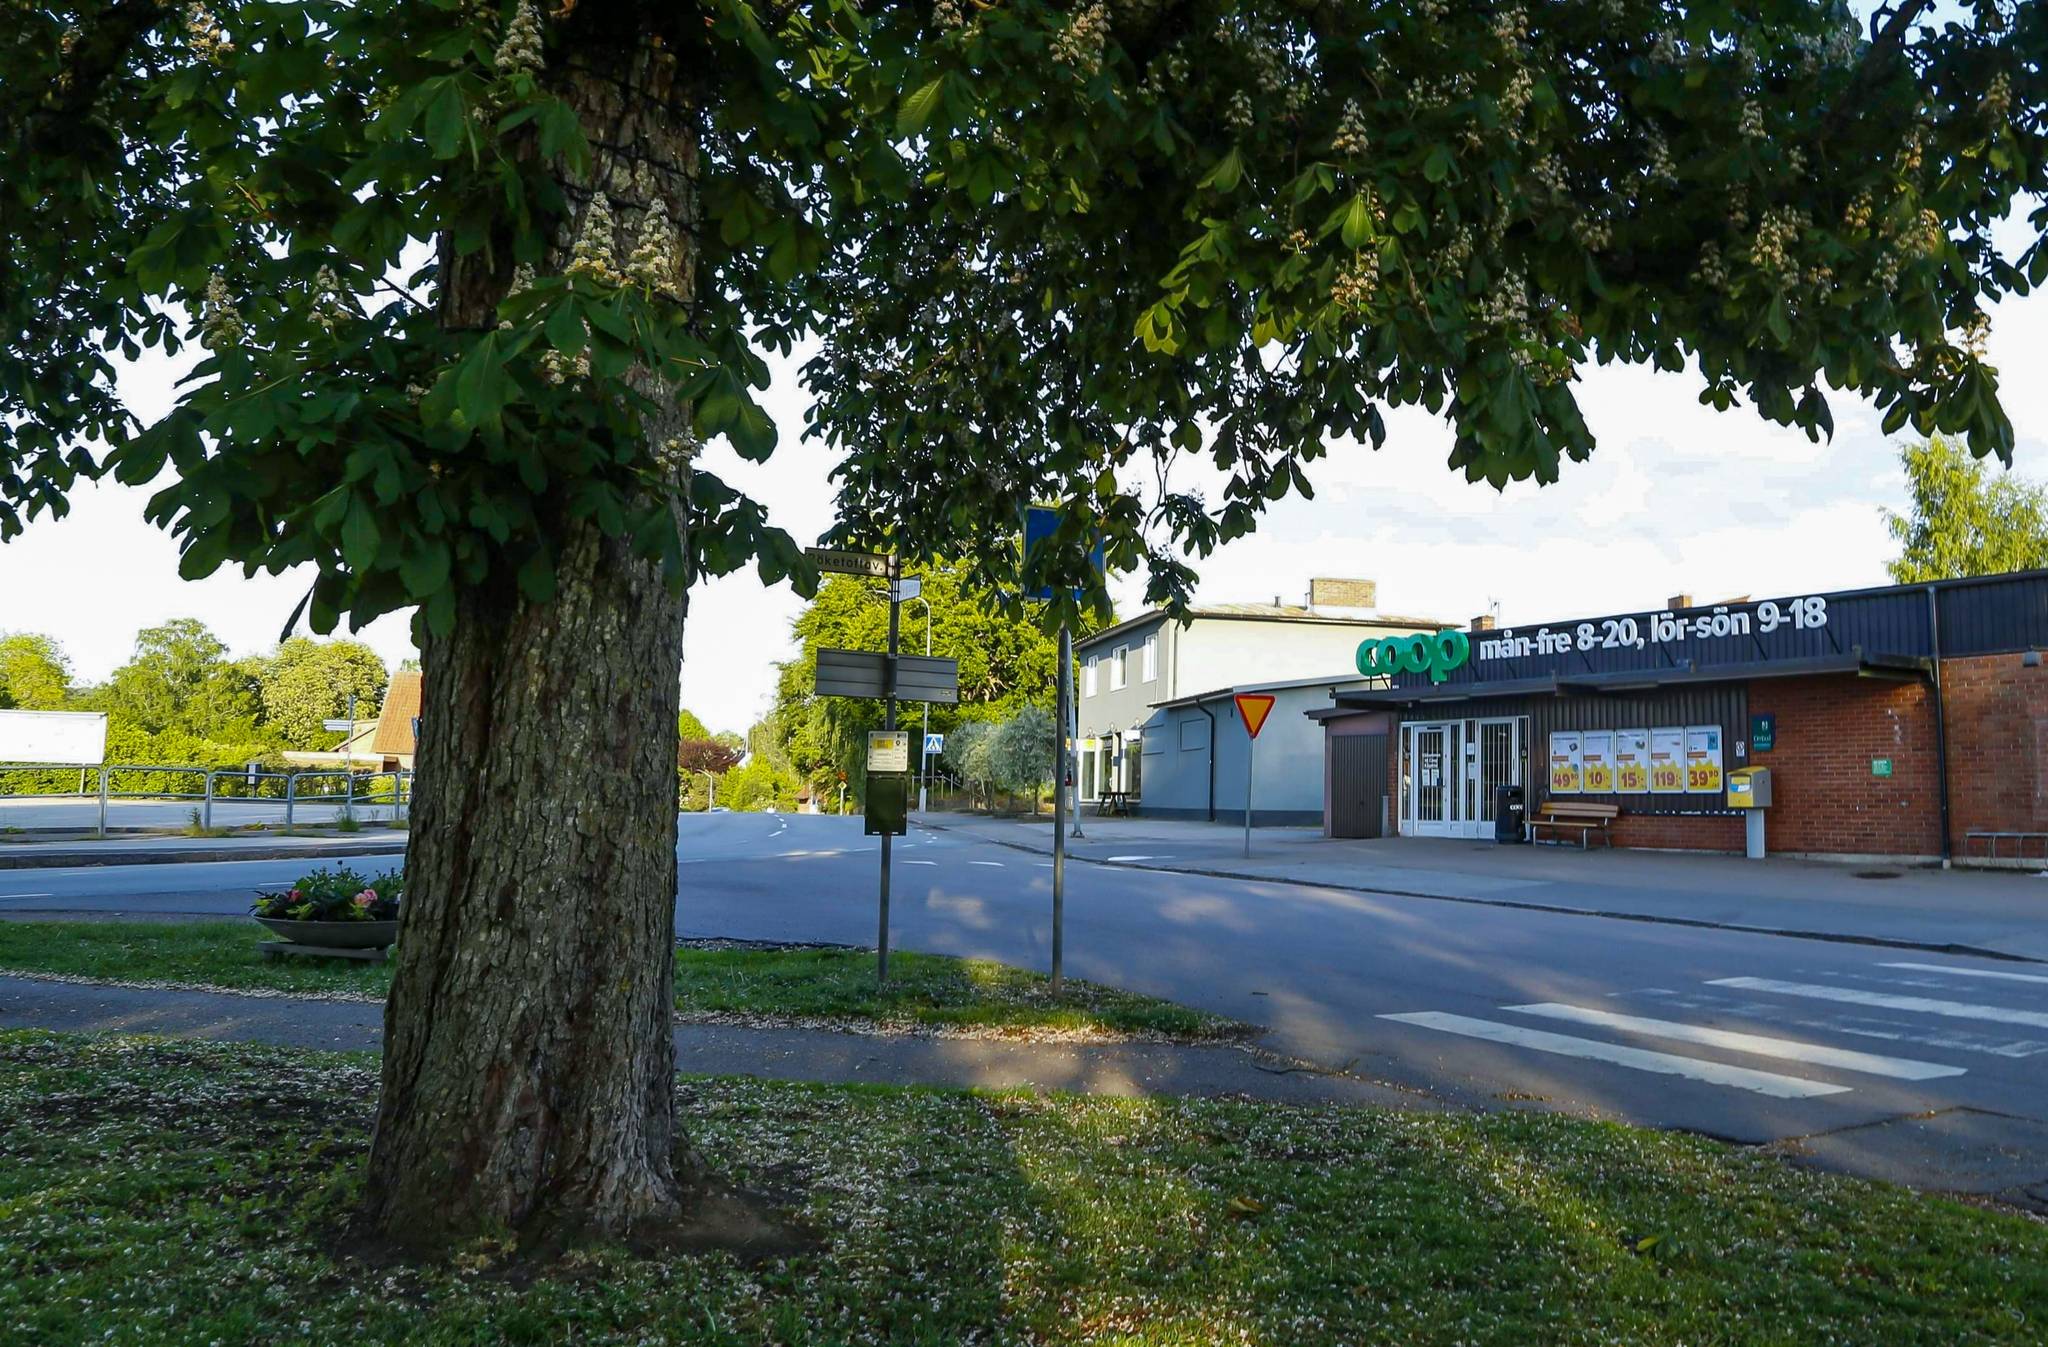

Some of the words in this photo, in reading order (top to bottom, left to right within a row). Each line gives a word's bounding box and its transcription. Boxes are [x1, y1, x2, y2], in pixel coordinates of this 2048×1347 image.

[1356, 630, 1470, 682] coop
[1480, 629, 1572, 660] mån-fre
[1576, 618, 1645, 650] 8-20,
[1650, 606, 1750, 643] lör-sön
[1757, 596, 1827, 633] 9-18
